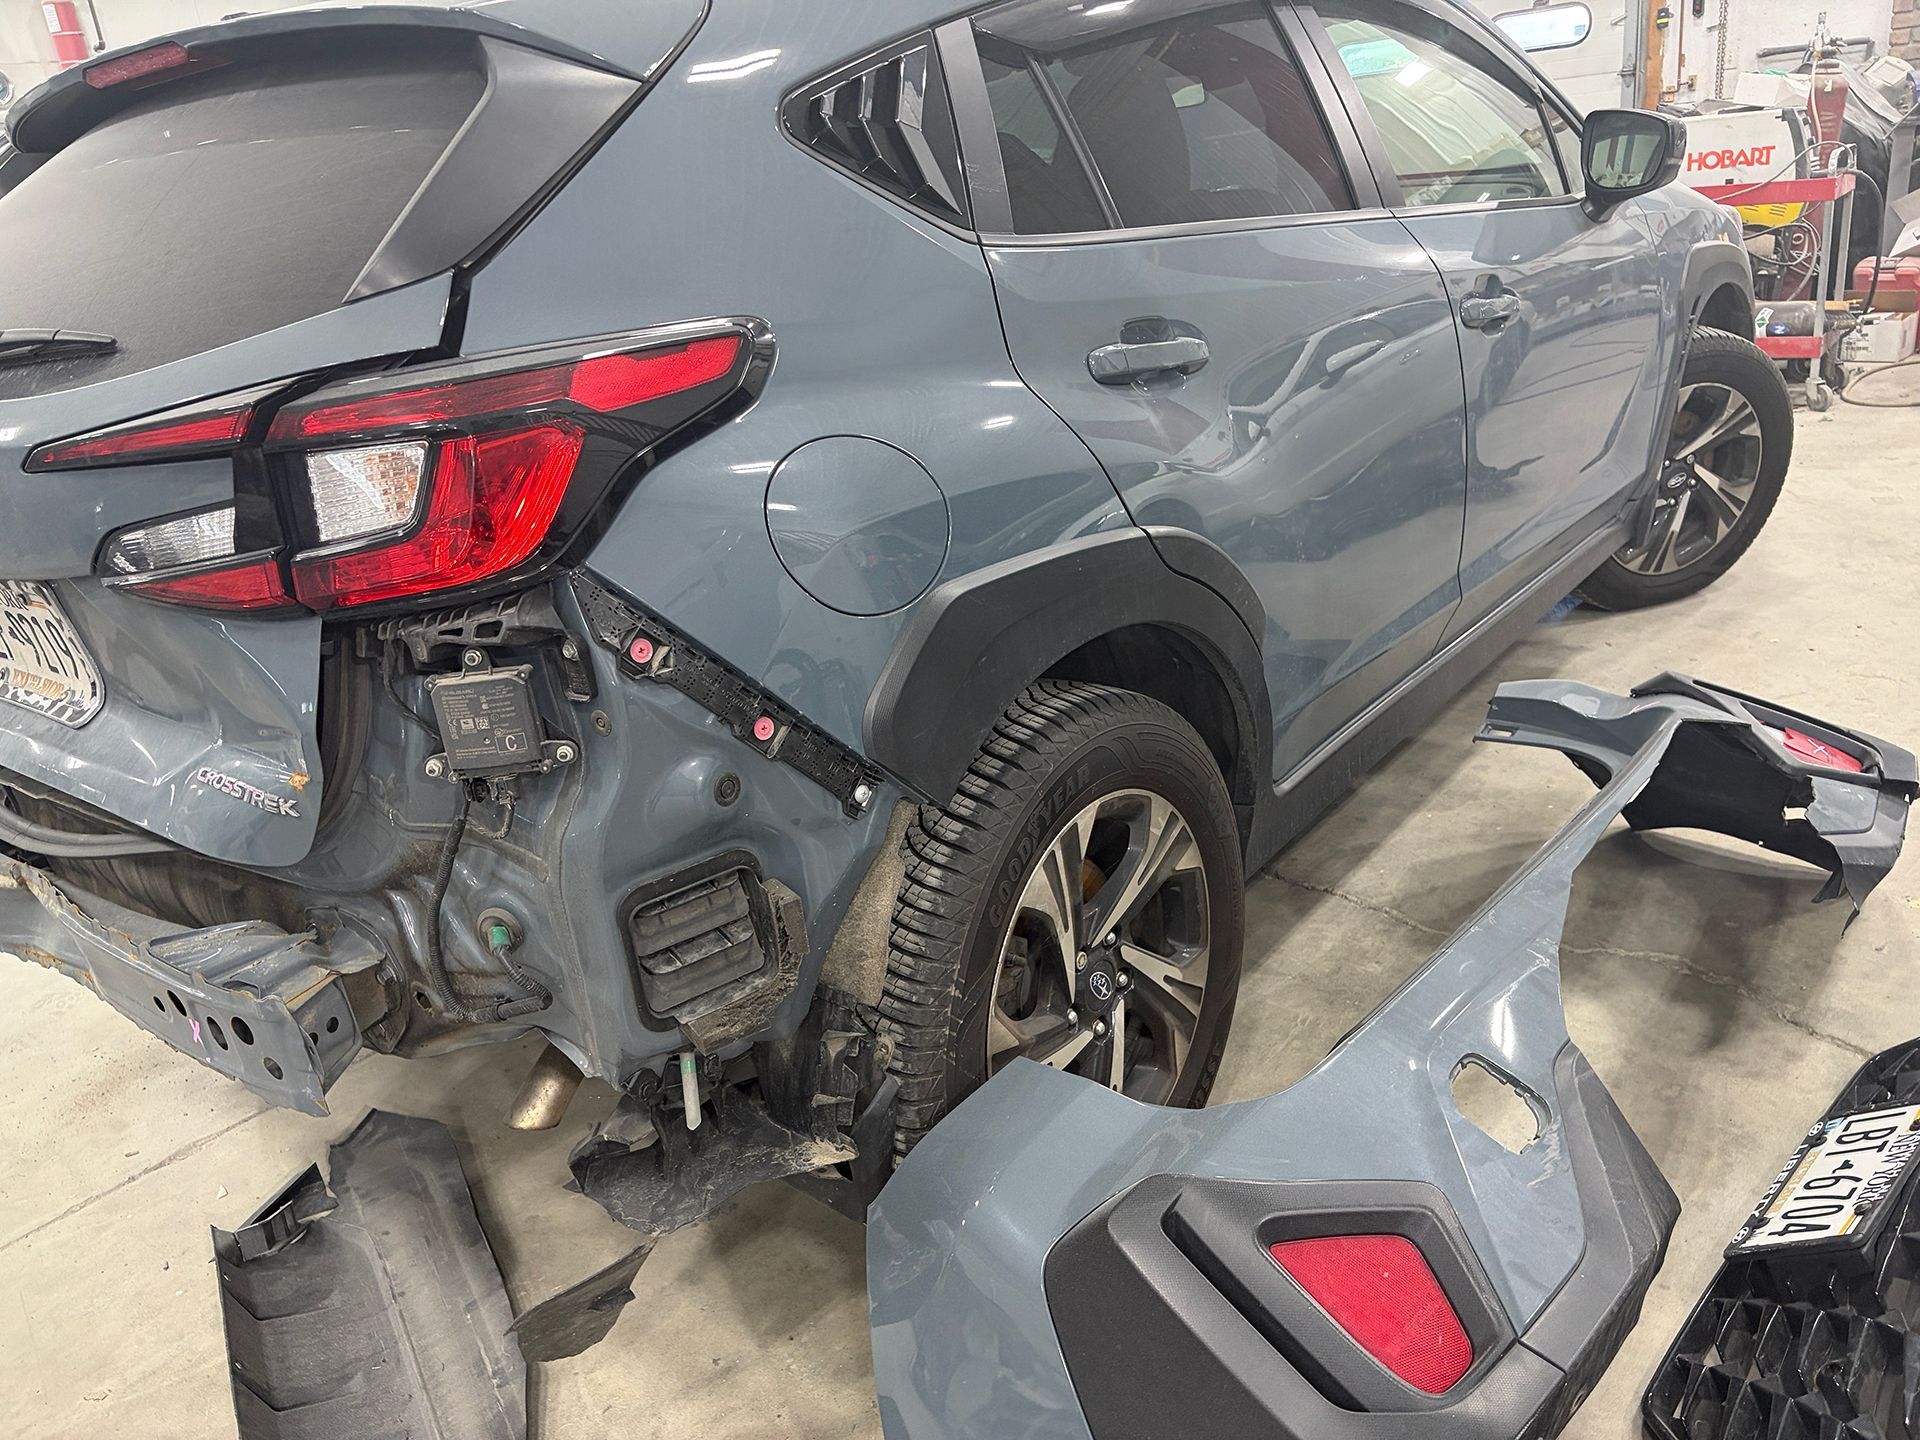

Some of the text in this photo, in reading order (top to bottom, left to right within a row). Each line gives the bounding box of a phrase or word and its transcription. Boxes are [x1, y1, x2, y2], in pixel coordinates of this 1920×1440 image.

[1687, 145, 1776, 172] HOBART
[0, 588, 29, 611] ORK
[505, 734, 517, 751] C
[197, 766, 301, 817] CROSSTREK
[989, 763, 1090, 928] GOODYEAR
[1880, 1131, 1917, 1163] NEW
[1751, 1143, 1809, 1218] LIBERTY
